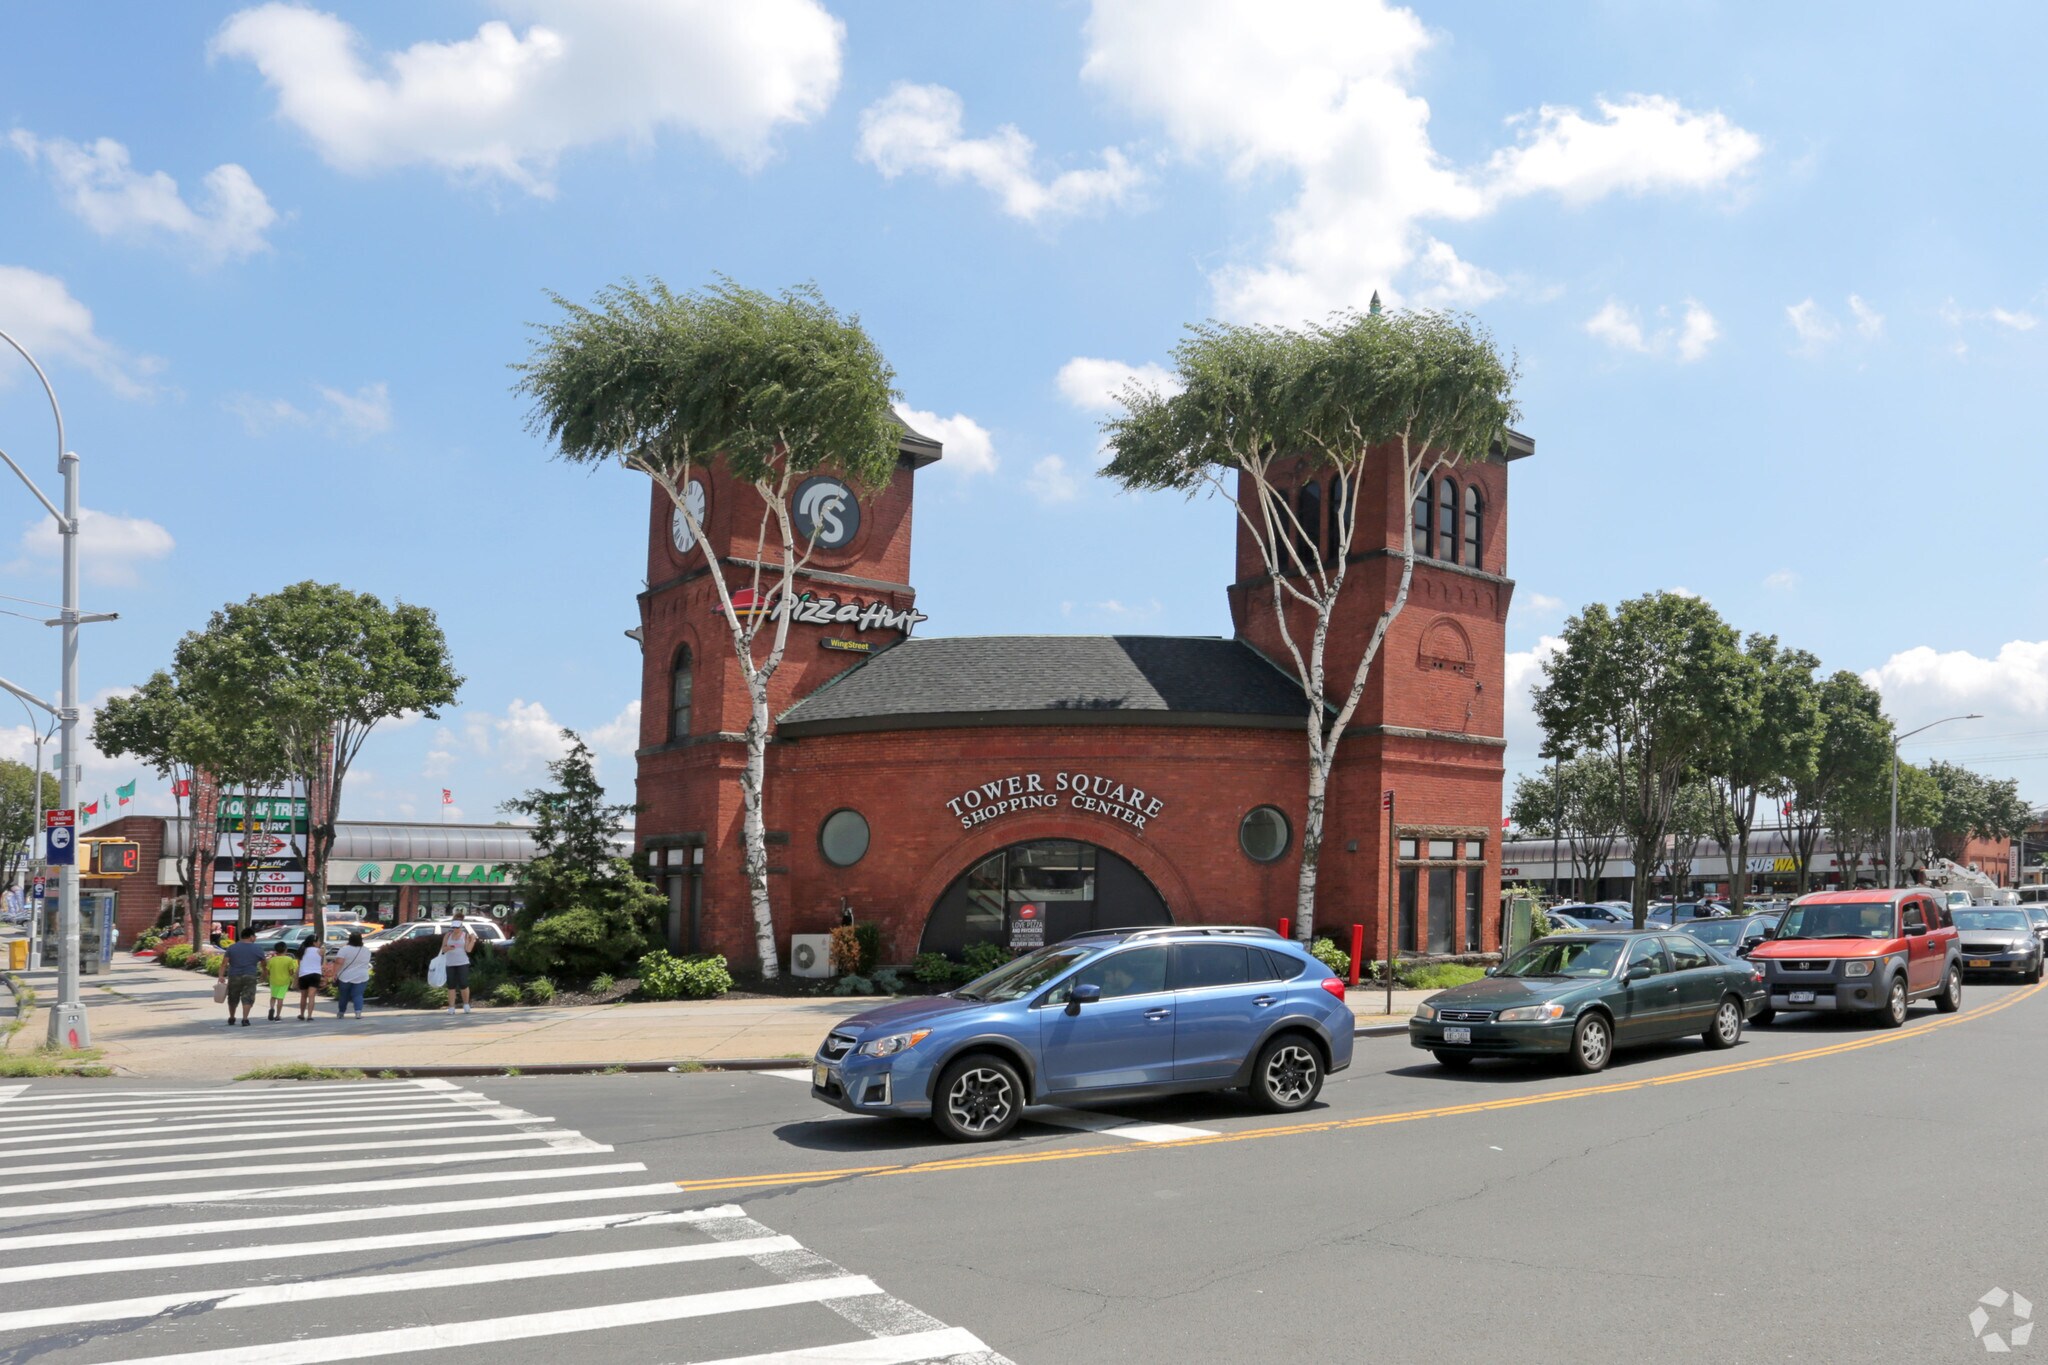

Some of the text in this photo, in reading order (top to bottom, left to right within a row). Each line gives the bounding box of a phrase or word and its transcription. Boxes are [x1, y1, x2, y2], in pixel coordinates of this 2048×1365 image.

[770, 590, 928, 636] Pizza Hut
[831, 638, 869, 651] WingStreet
[946, 772, 1164, 819] TOWER SQUARE
[219, 800, 306, 817] DOLAR TREE
[961, 794, 1147, 830] SHOPPING CENTER
[236, 821, 289, 831] SBWAY
[123, 849, 137, 868] 12
[390, 863, 506, 883] DOLLAR
[227, 885, 292, 894] GaeStop
